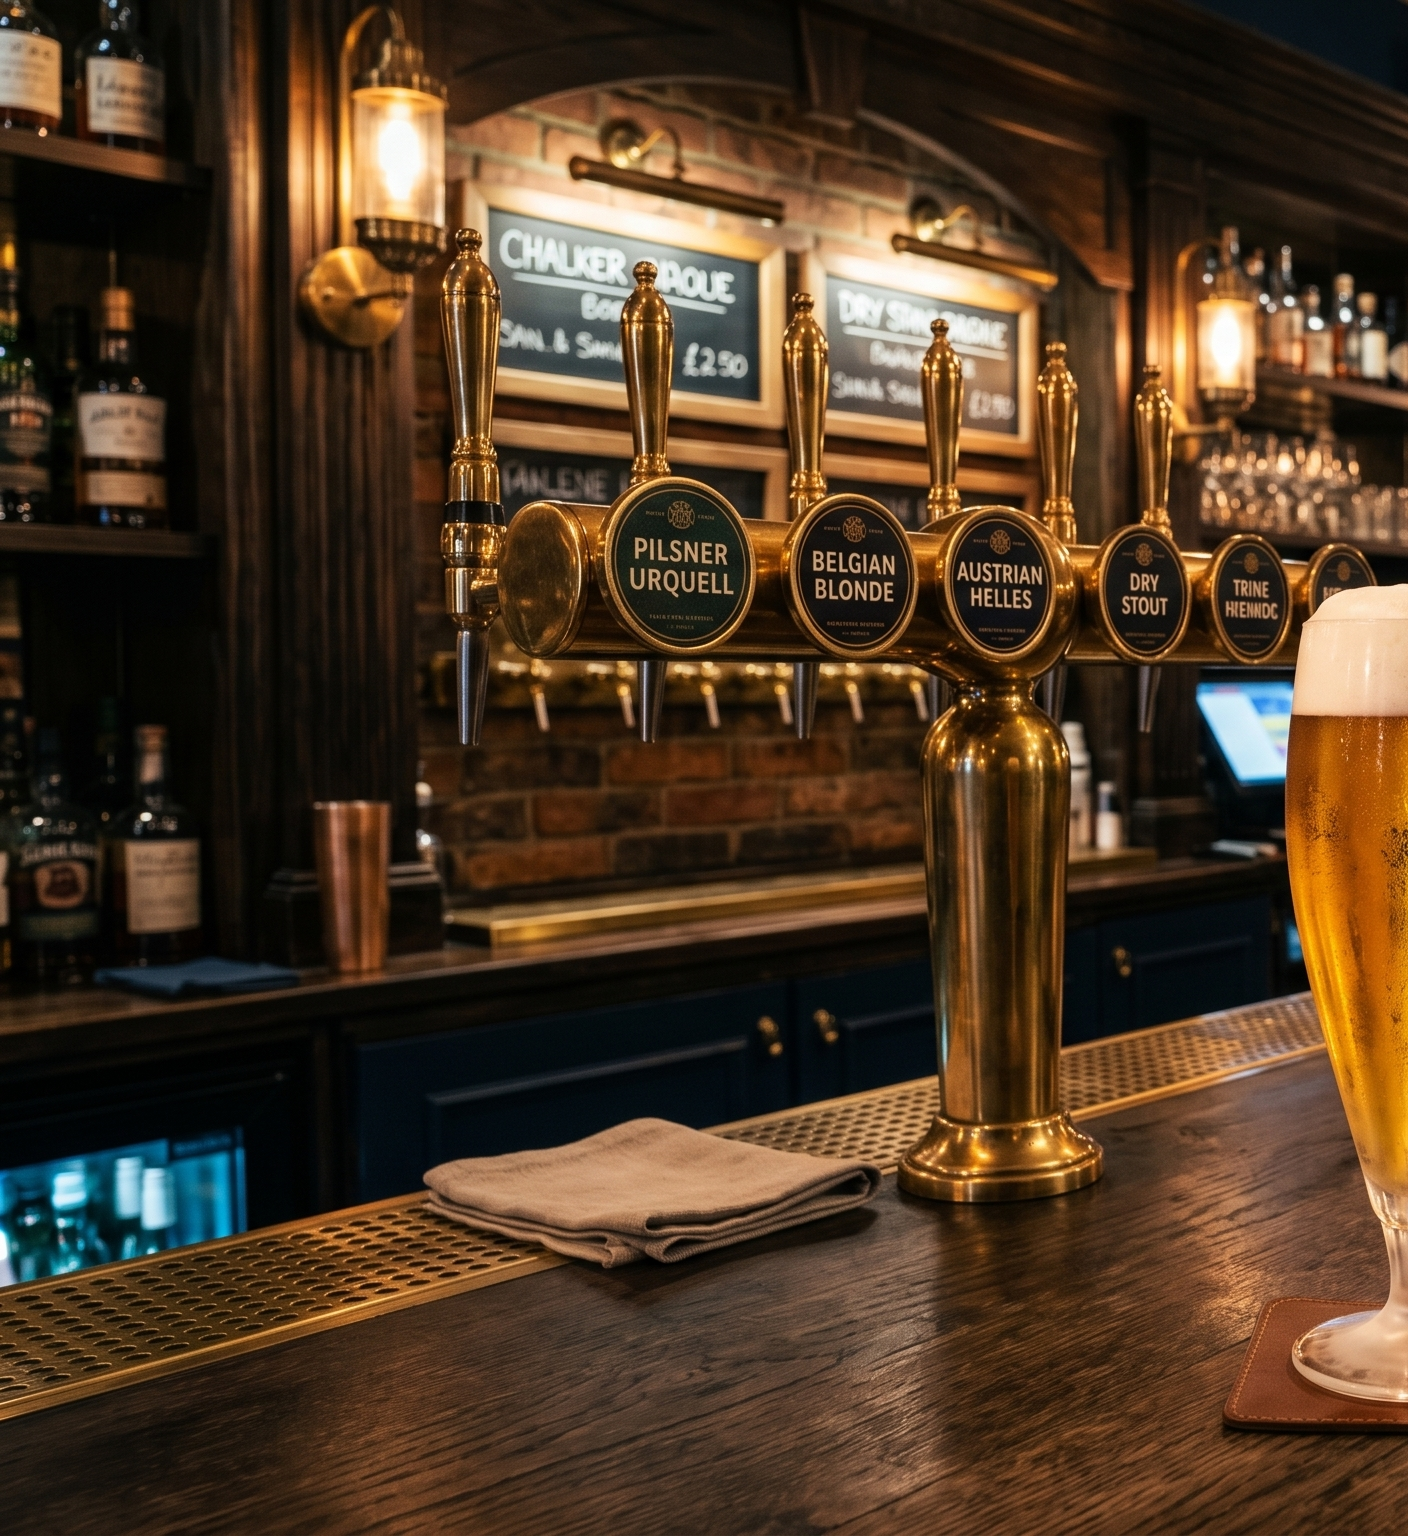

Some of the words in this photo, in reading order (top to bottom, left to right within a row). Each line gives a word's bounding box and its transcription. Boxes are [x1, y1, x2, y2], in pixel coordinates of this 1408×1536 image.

[634, 537, 728, 565] PILSNER
[812, 550, 895, 575] BELGIAN
[629, 567, 734, 598] URQUELL
[957, 561, 1042, 585] AUSTRIAN
[1130, 572, 1159, 592] DRY
[815, 578, 894, 602] BLONDE
[970, 587, 1032, 609] HELLES
[1233, 578, 1269, 598] TRINE
[1122, 595, 1168, 616] STOUT
